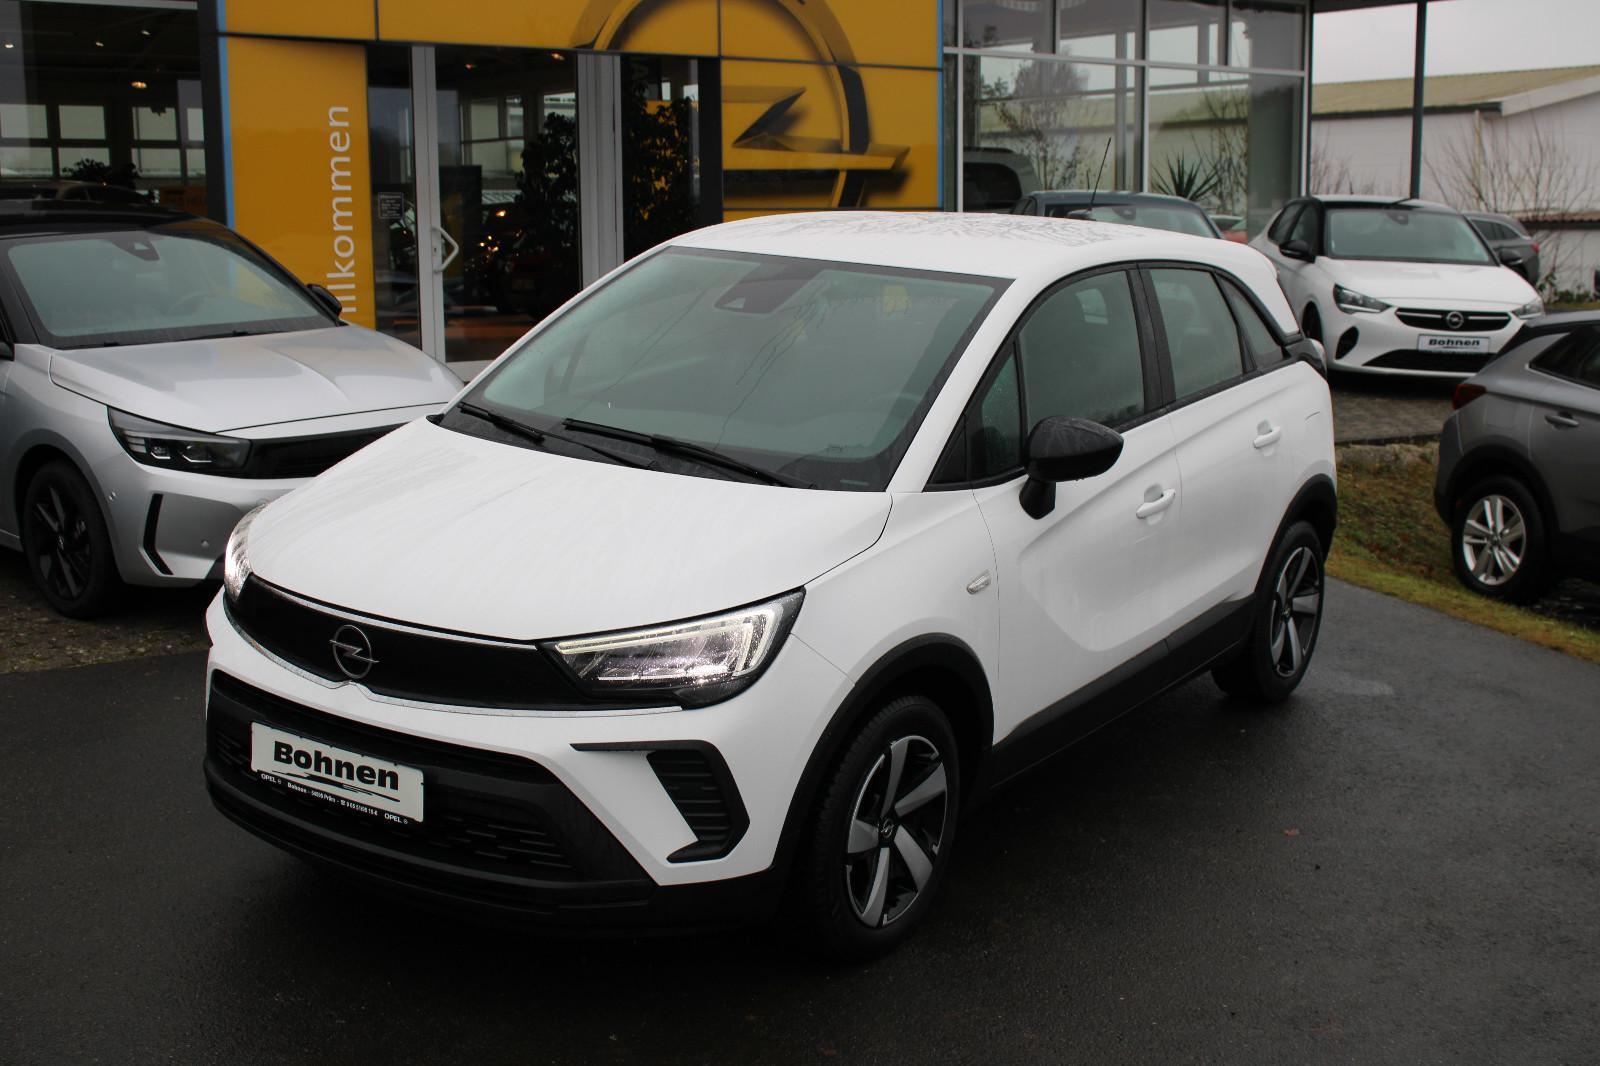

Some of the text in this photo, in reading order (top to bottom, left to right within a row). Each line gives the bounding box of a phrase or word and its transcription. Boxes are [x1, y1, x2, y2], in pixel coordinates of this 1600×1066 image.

[327, 106, 357, 313] illkommen
[1428, 338, 1480, 346] Bohnen
[274, 741, 398, 790] Bohnen
[261, 773, 277, 783] OPEL
[384, 813, 403, 823] OPEL
